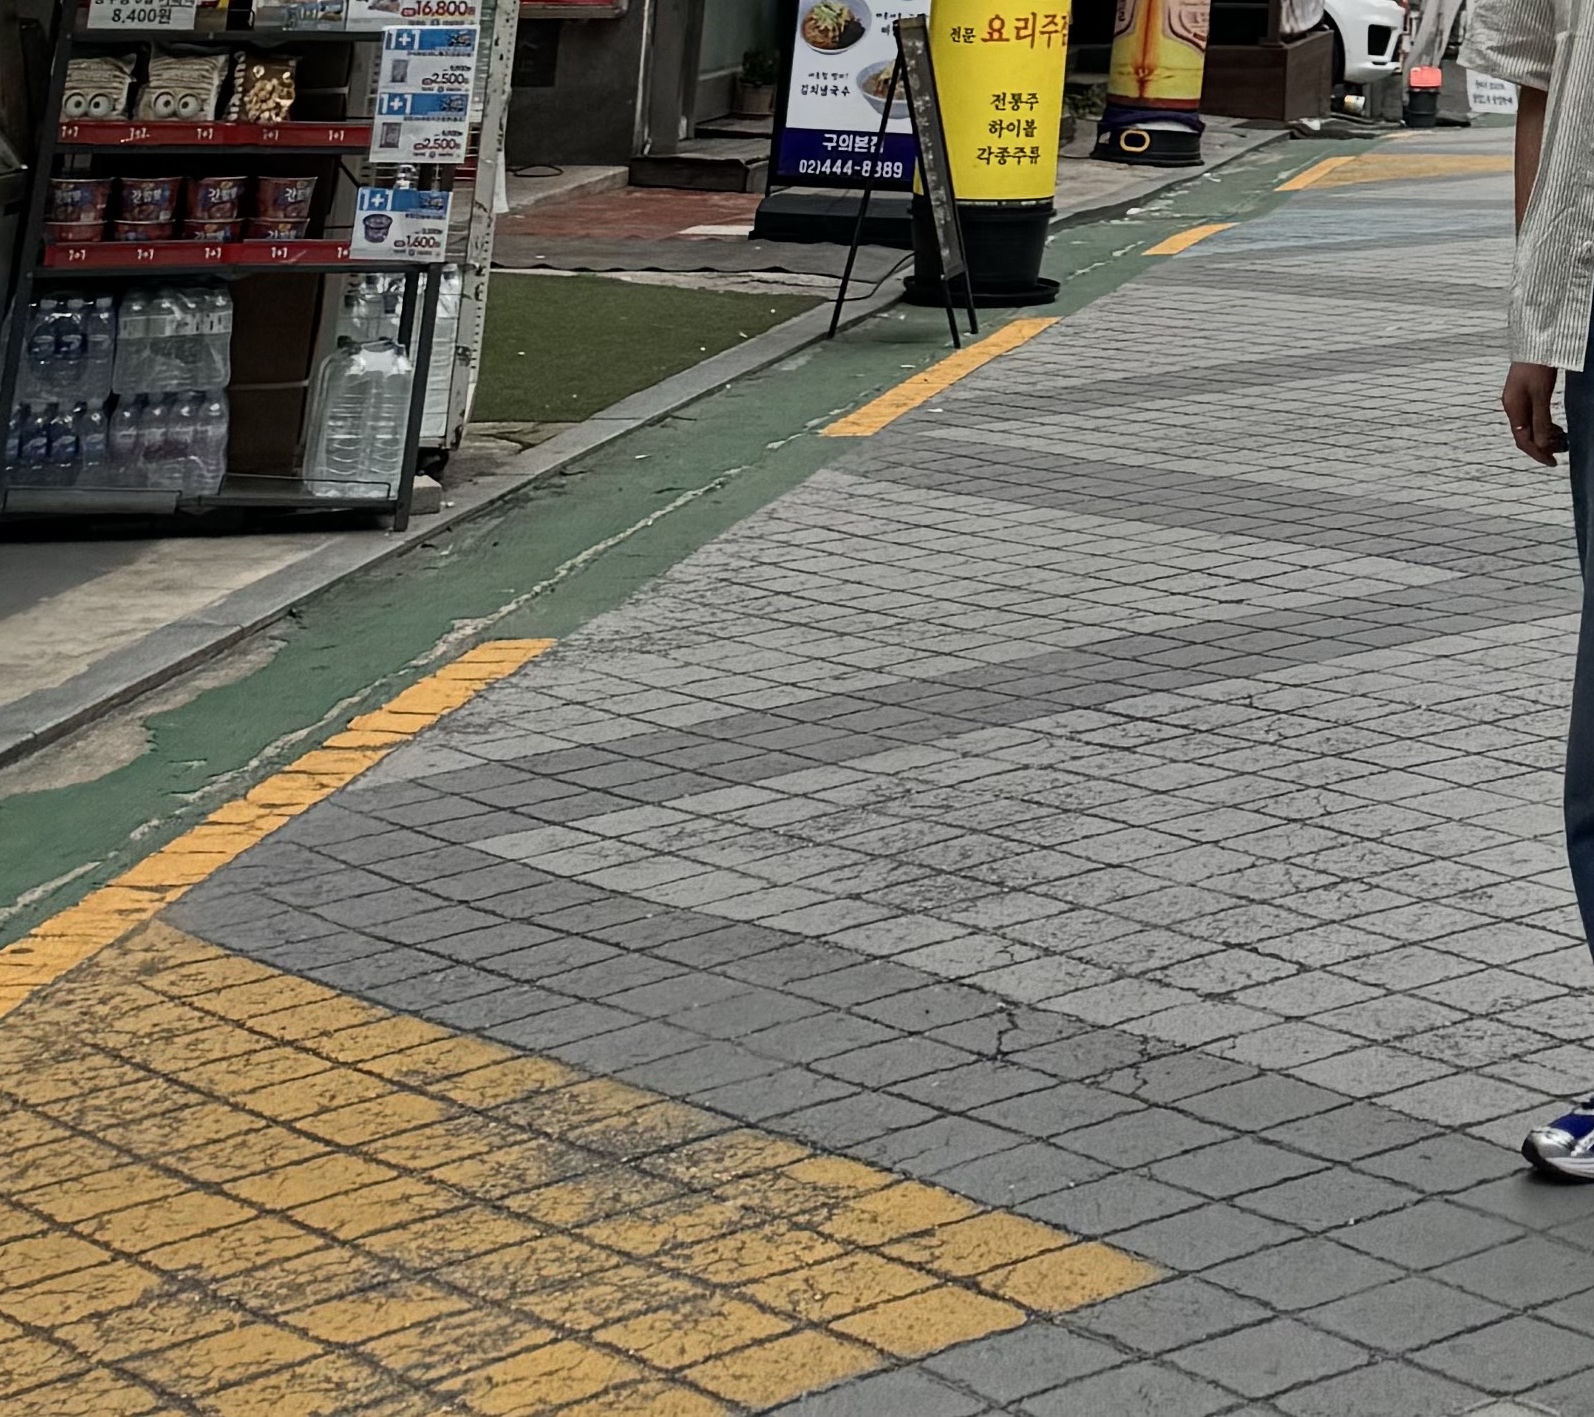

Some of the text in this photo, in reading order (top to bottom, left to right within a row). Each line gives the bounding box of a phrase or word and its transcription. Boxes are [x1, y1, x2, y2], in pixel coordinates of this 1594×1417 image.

[388, 29, 420, 49] 1+1
[381, 94, 412, 113] 1+1
[991, 92, 1039, 111] 전통주
[988, 118, 1036, 138] 하이볼
[977, 145, 1041, 166] 각종주류
[363, 189, 393, 210] 1+1
